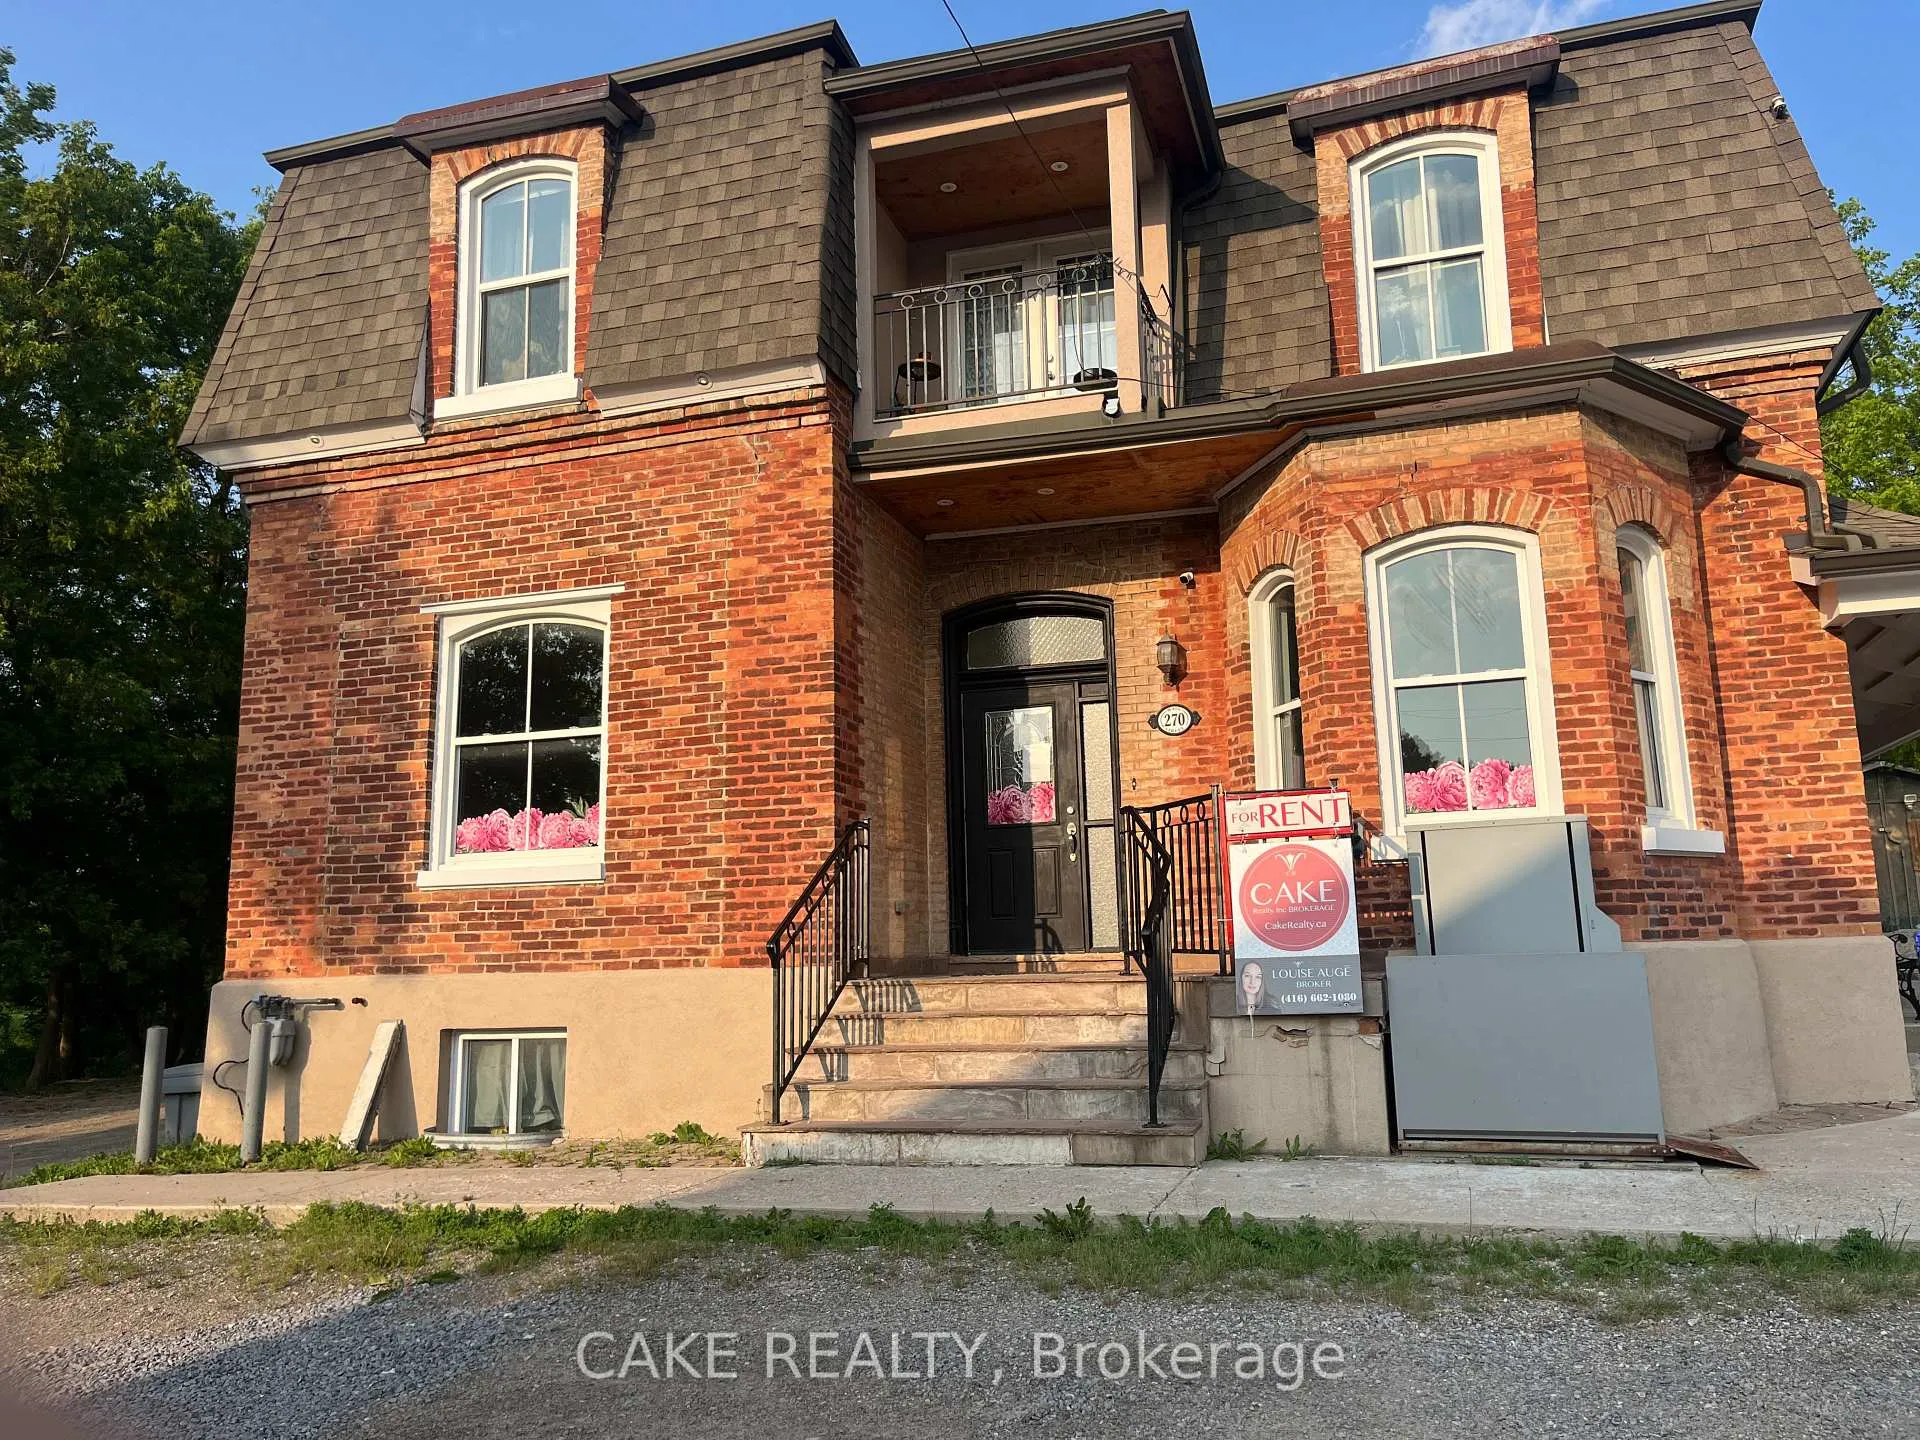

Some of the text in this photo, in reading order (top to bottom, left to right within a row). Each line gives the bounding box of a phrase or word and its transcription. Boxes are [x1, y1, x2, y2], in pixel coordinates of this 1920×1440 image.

[1164, 712, 1185, 727] 270
[1231, 798, 1347, 828] FOR RENT
[1250, 879, 1337, 906] CAKE
[1264, 920, 1327, 930] CakeRealty.ca
[1272, 968, 1314, 979] LOUISE
[1296, 980, 1332, 989] BROKER
[1281, 992, 1357, 1004] (416) 662-1080
